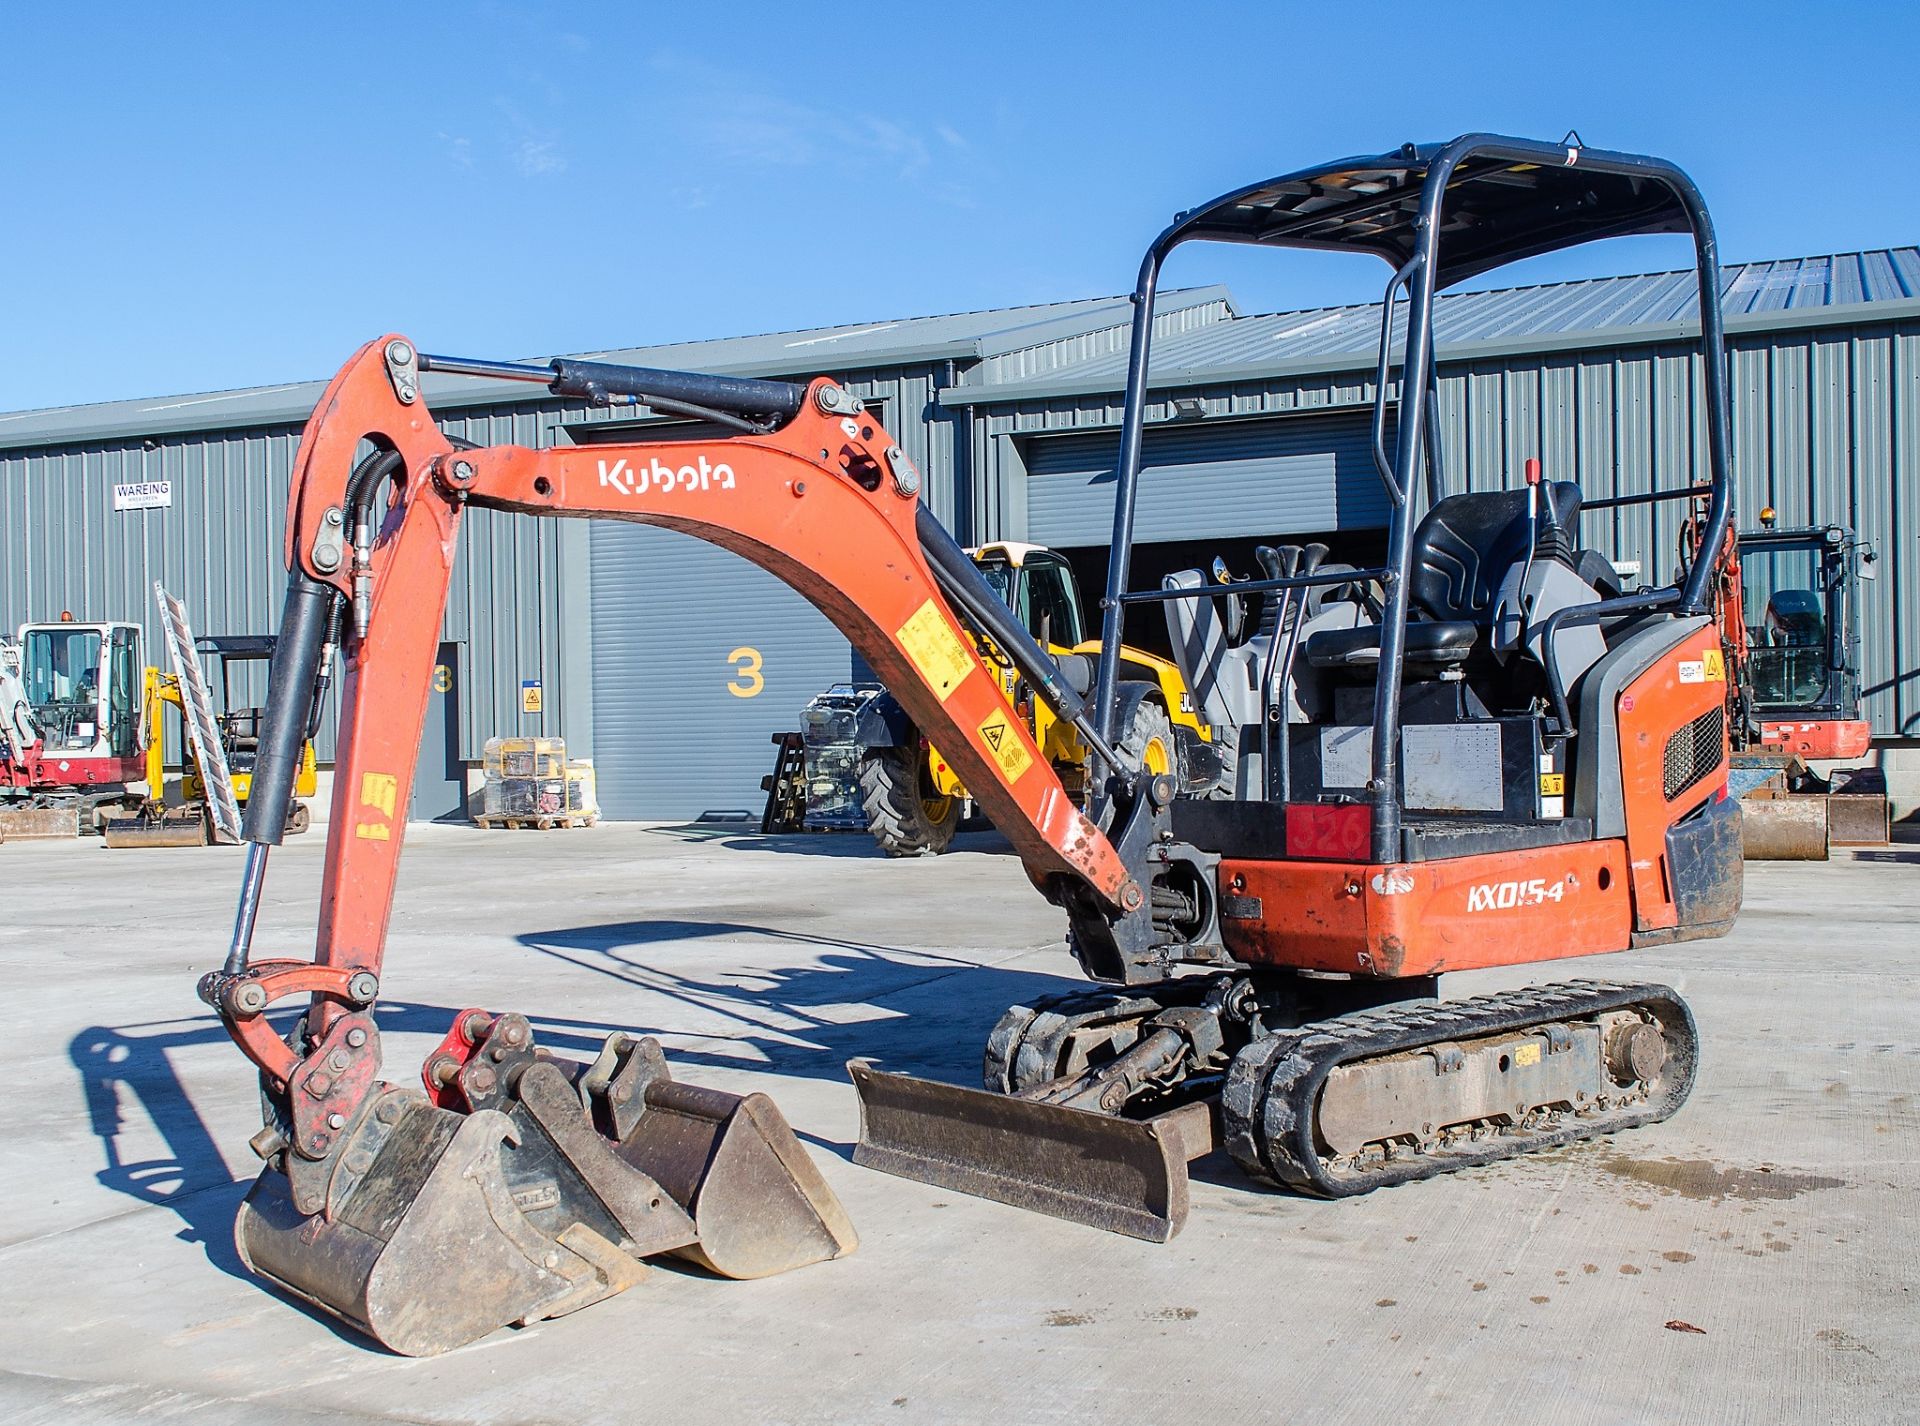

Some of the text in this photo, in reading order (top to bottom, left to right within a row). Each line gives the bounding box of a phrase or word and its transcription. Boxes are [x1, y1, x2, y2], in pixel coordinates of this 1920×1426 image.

[117, 483, 169, 497] WAREING
[597, 455, 736, 495] Kubota
[433, 664, 453, 693] 3
[727, 646, 764, 698] 3
